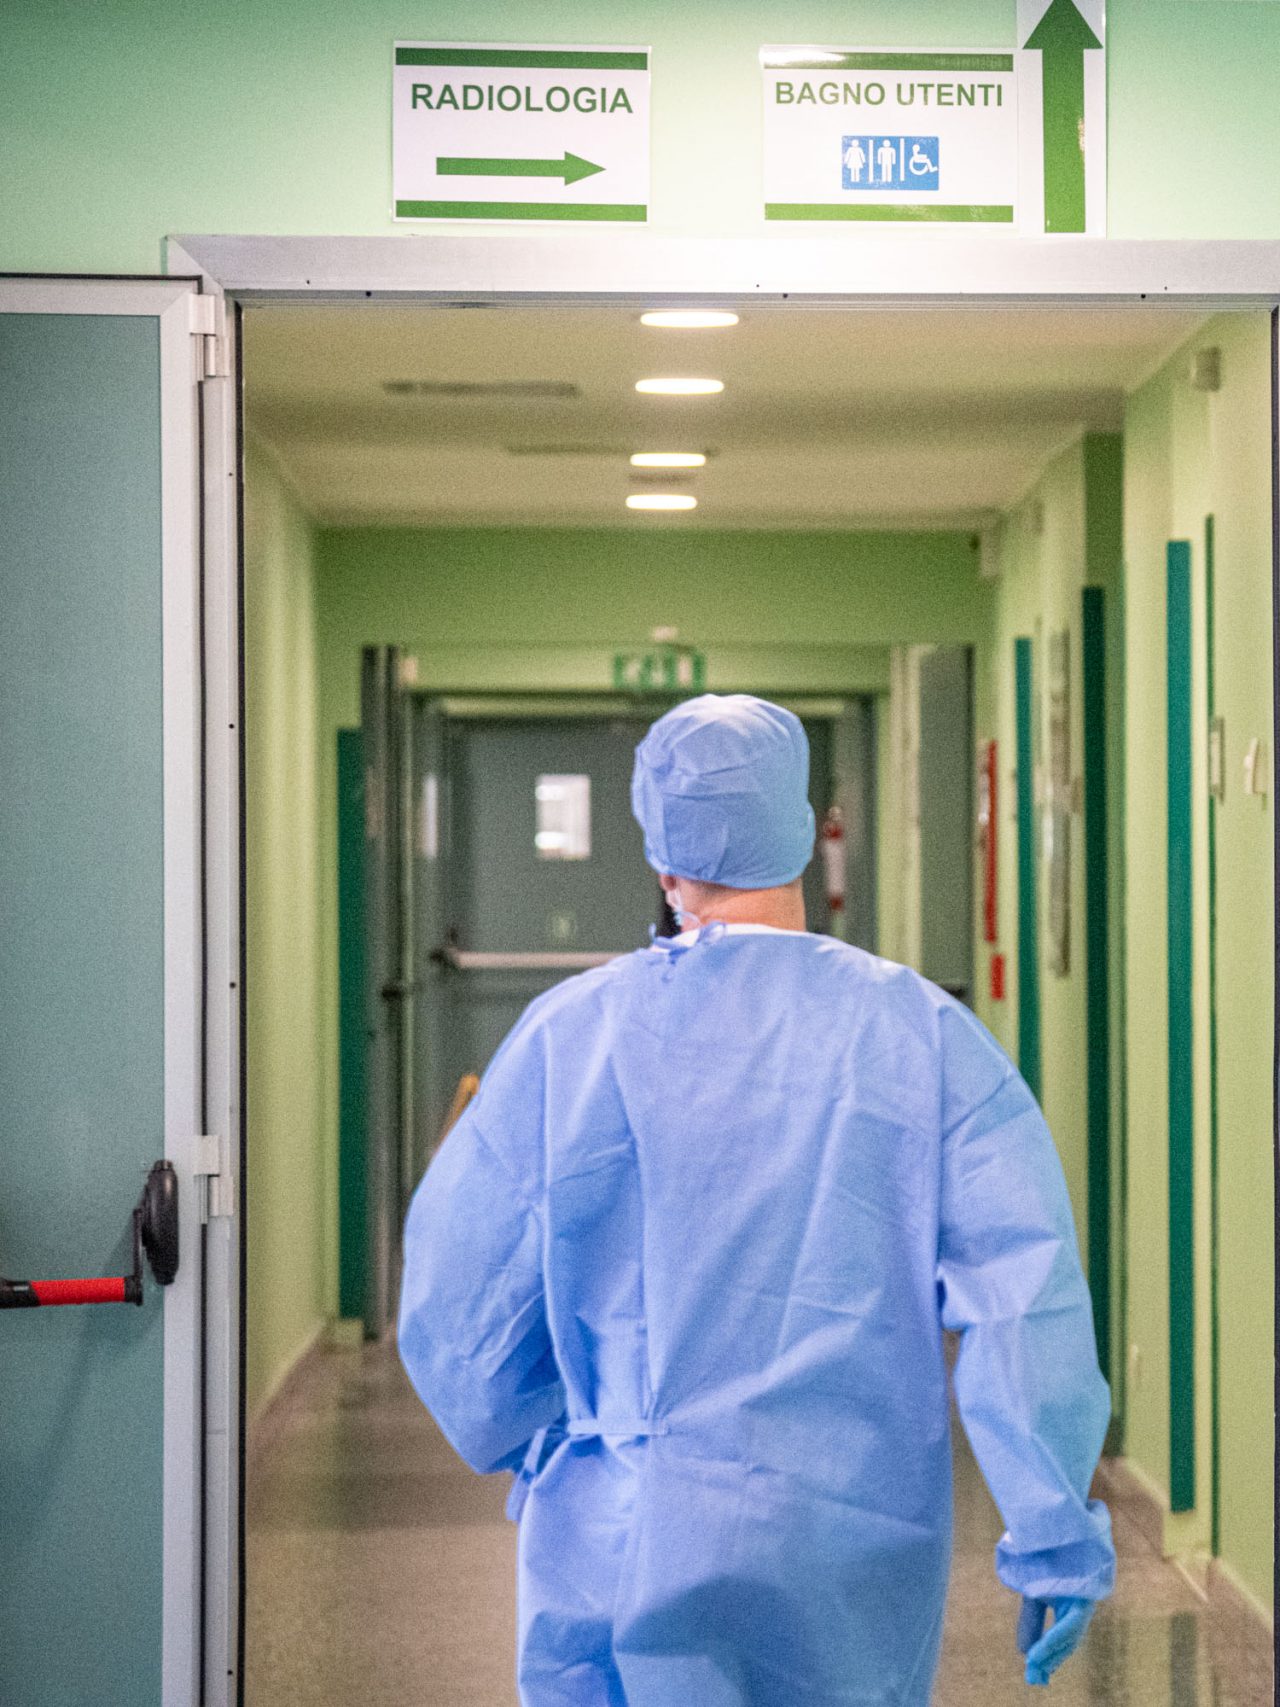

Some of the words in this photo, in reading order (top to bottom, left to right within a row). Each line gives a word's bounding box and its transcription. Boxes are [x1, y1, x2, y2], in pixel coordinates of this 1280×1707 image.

[410, 83, 633, 114] RADIOLOGIA
[774, 80, 887, 107] BAGNO
[895, 82, 1004, 108] UTENTI
